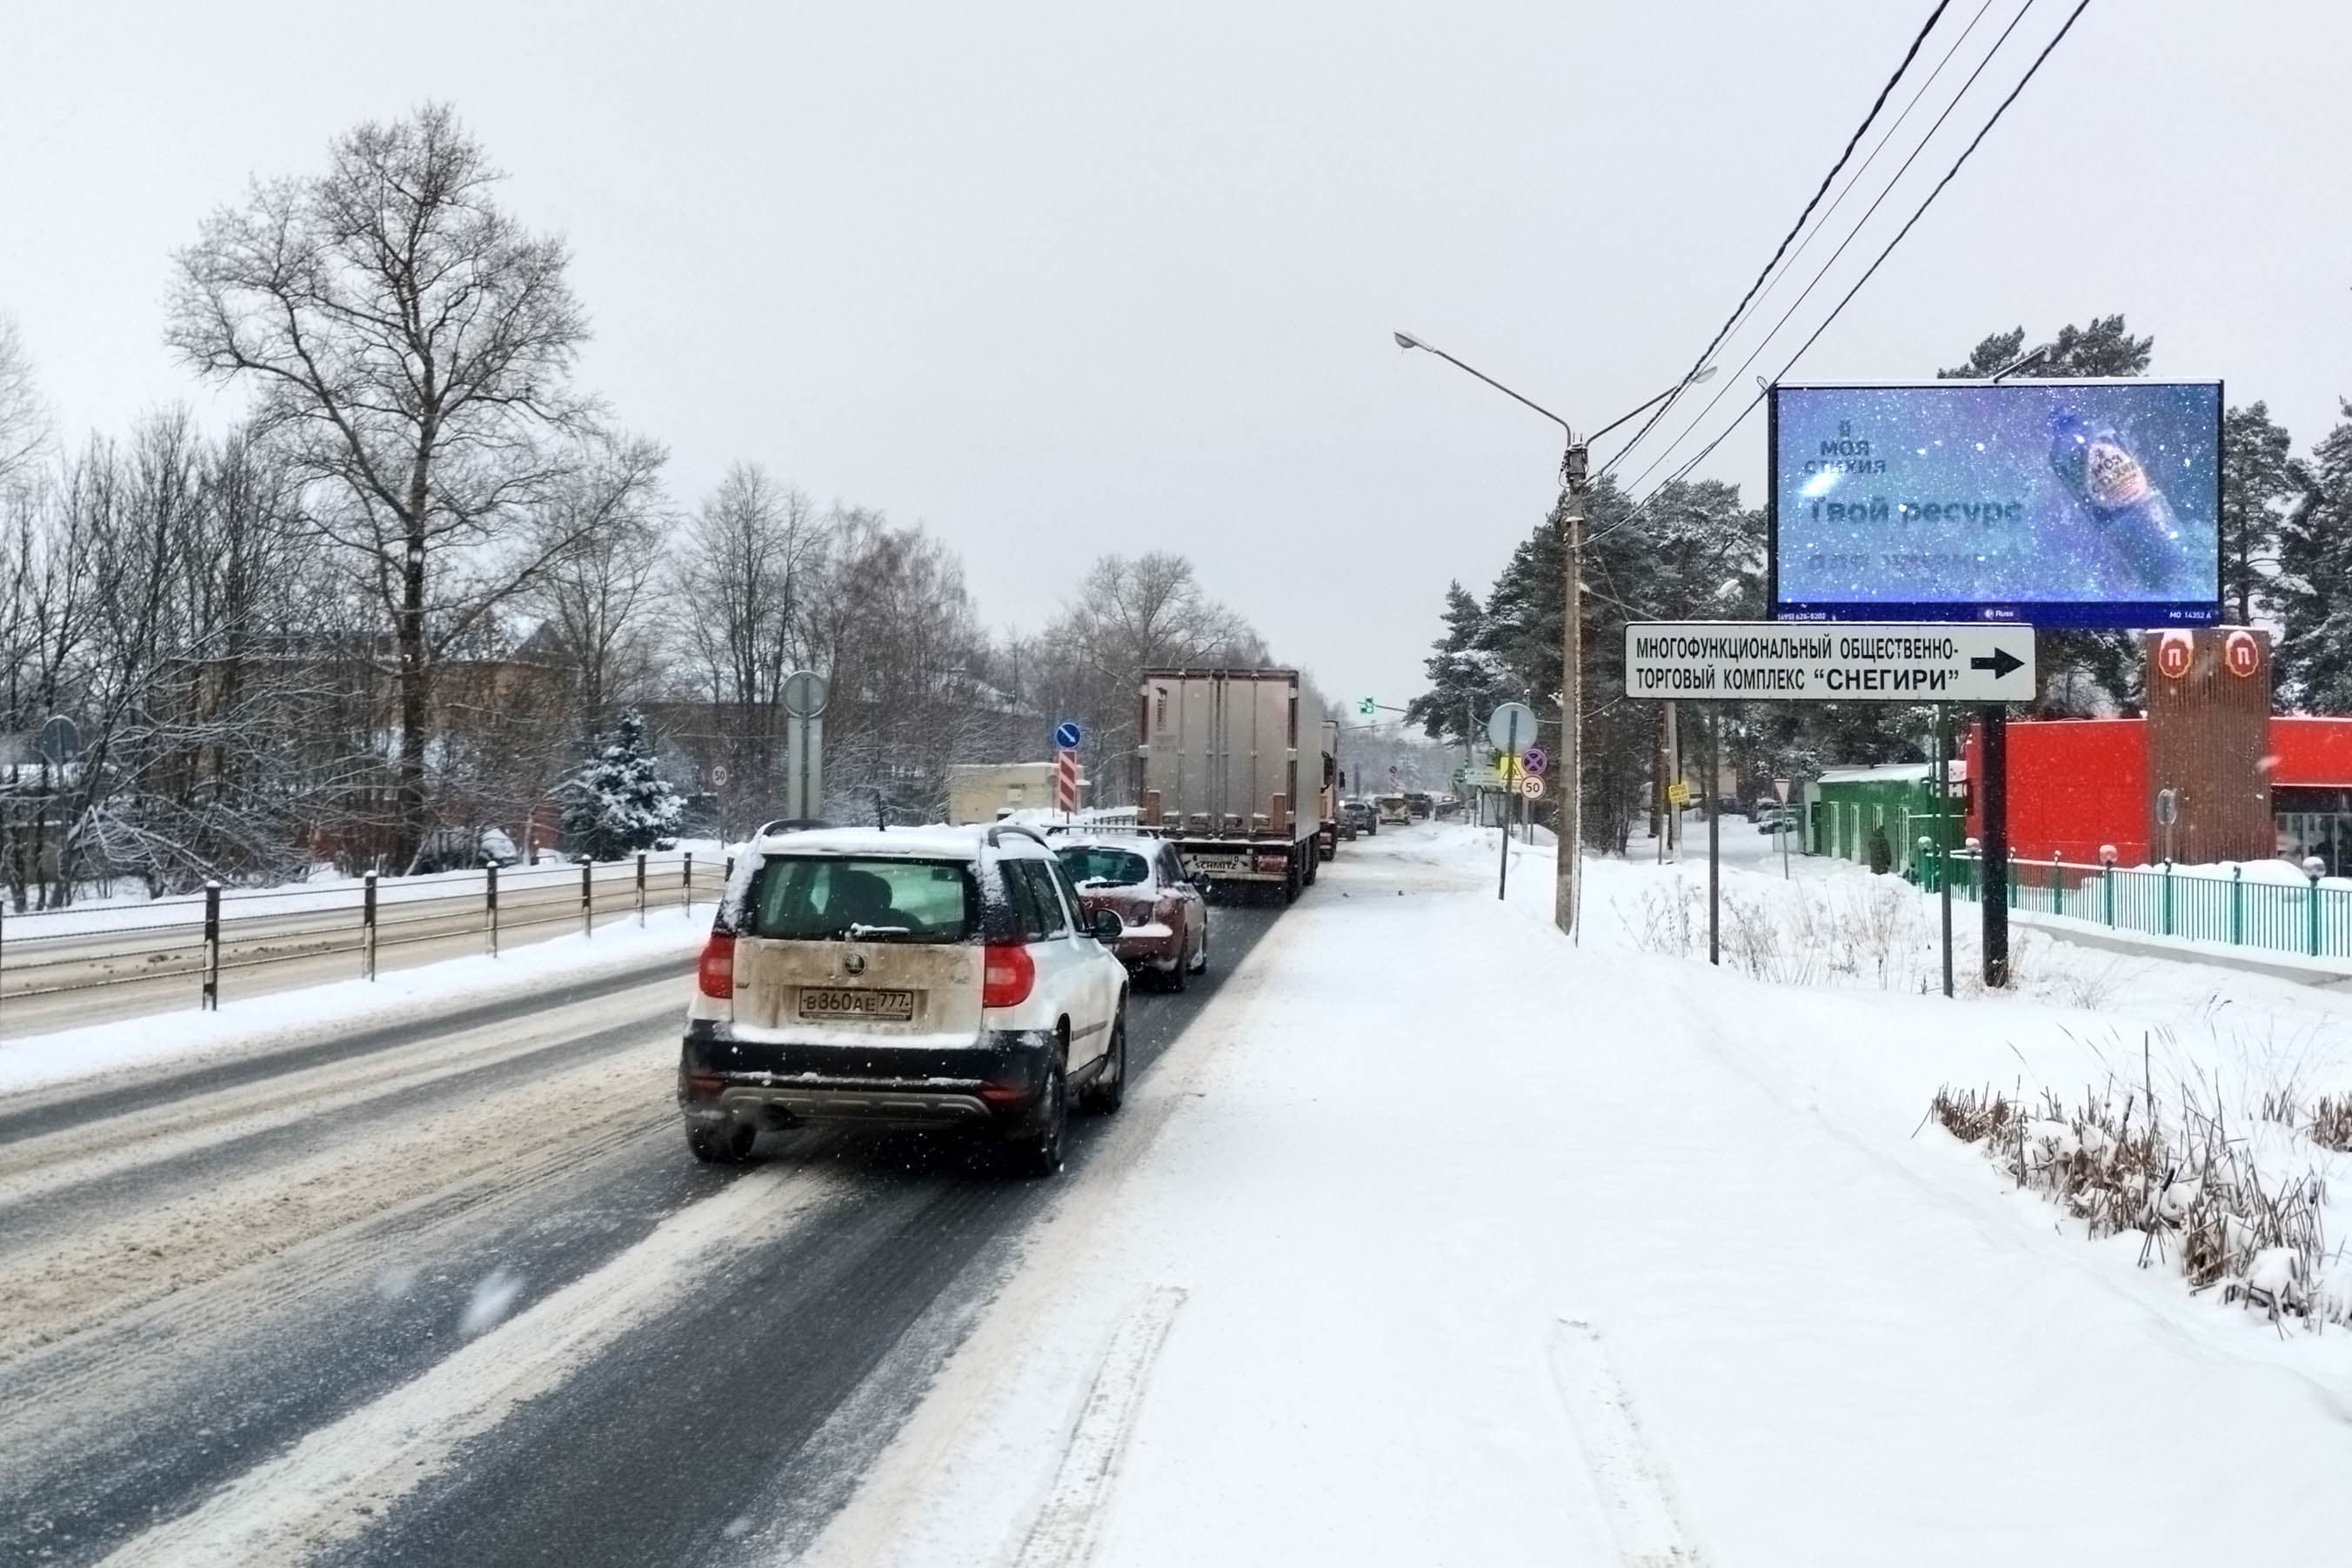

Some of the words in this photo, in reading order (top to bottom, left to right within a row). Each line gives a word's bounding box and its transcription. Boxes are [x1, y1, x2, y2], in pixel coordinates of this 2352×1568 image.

[1821, 440, 1869, 456] МОЯ
[1635, 633, 1833, 664] МНОГОФУНКЦИОНАЛЬНЫЙ
[1840, 637, 1959, 664] ОБЩЕСТВЕННО-
[1636, 664, 1715, 690] ТОРГОВЫЙ
[1723, 668, 1806, 691] КОМПЛЕКС
[714, 770, 725, 782] 50
[1526, 782, 1540, 793] 50
[879, 993, 906, 1007] 777
